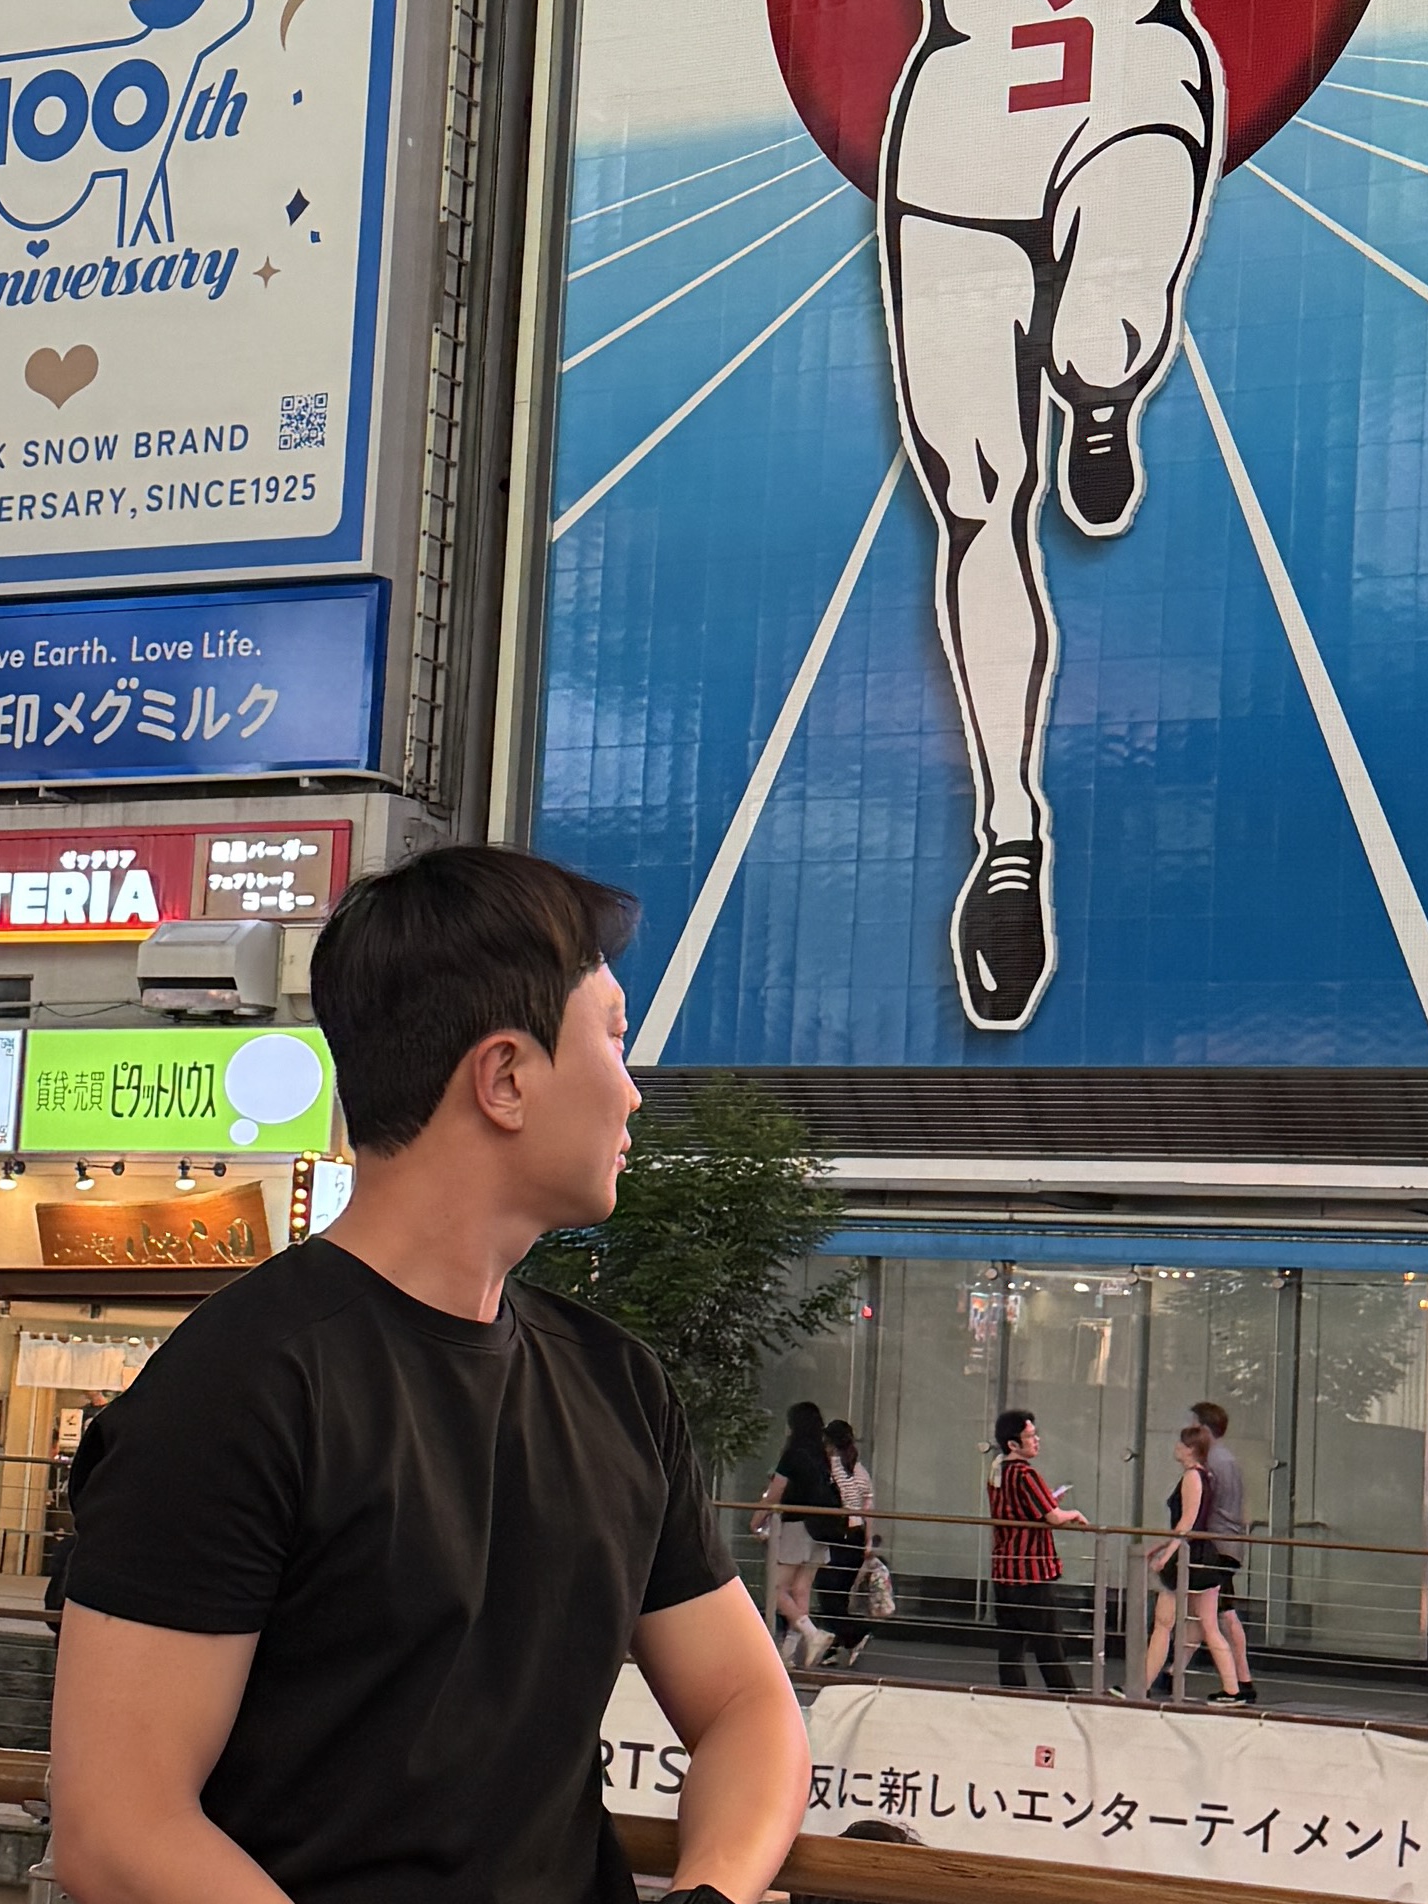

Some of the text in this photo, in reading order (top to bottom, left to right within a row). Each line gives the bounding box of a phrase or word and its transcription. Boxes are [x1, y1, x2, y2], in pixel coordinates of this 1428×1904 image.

[22, 433, 119, 468] SNOW
[133, 423, 251, 459] BRAND
[33, 637, 118, 667] Earth.
[130, 634, 193, 664] Love
[202, 630, 262, 660] Life.
[58, 849, 137, 871] ゼッテリア
[242, 890, 316, 912] コーヒー
[35, 1059, 218, 1120] 賃貸・売買 ピタットハウス
